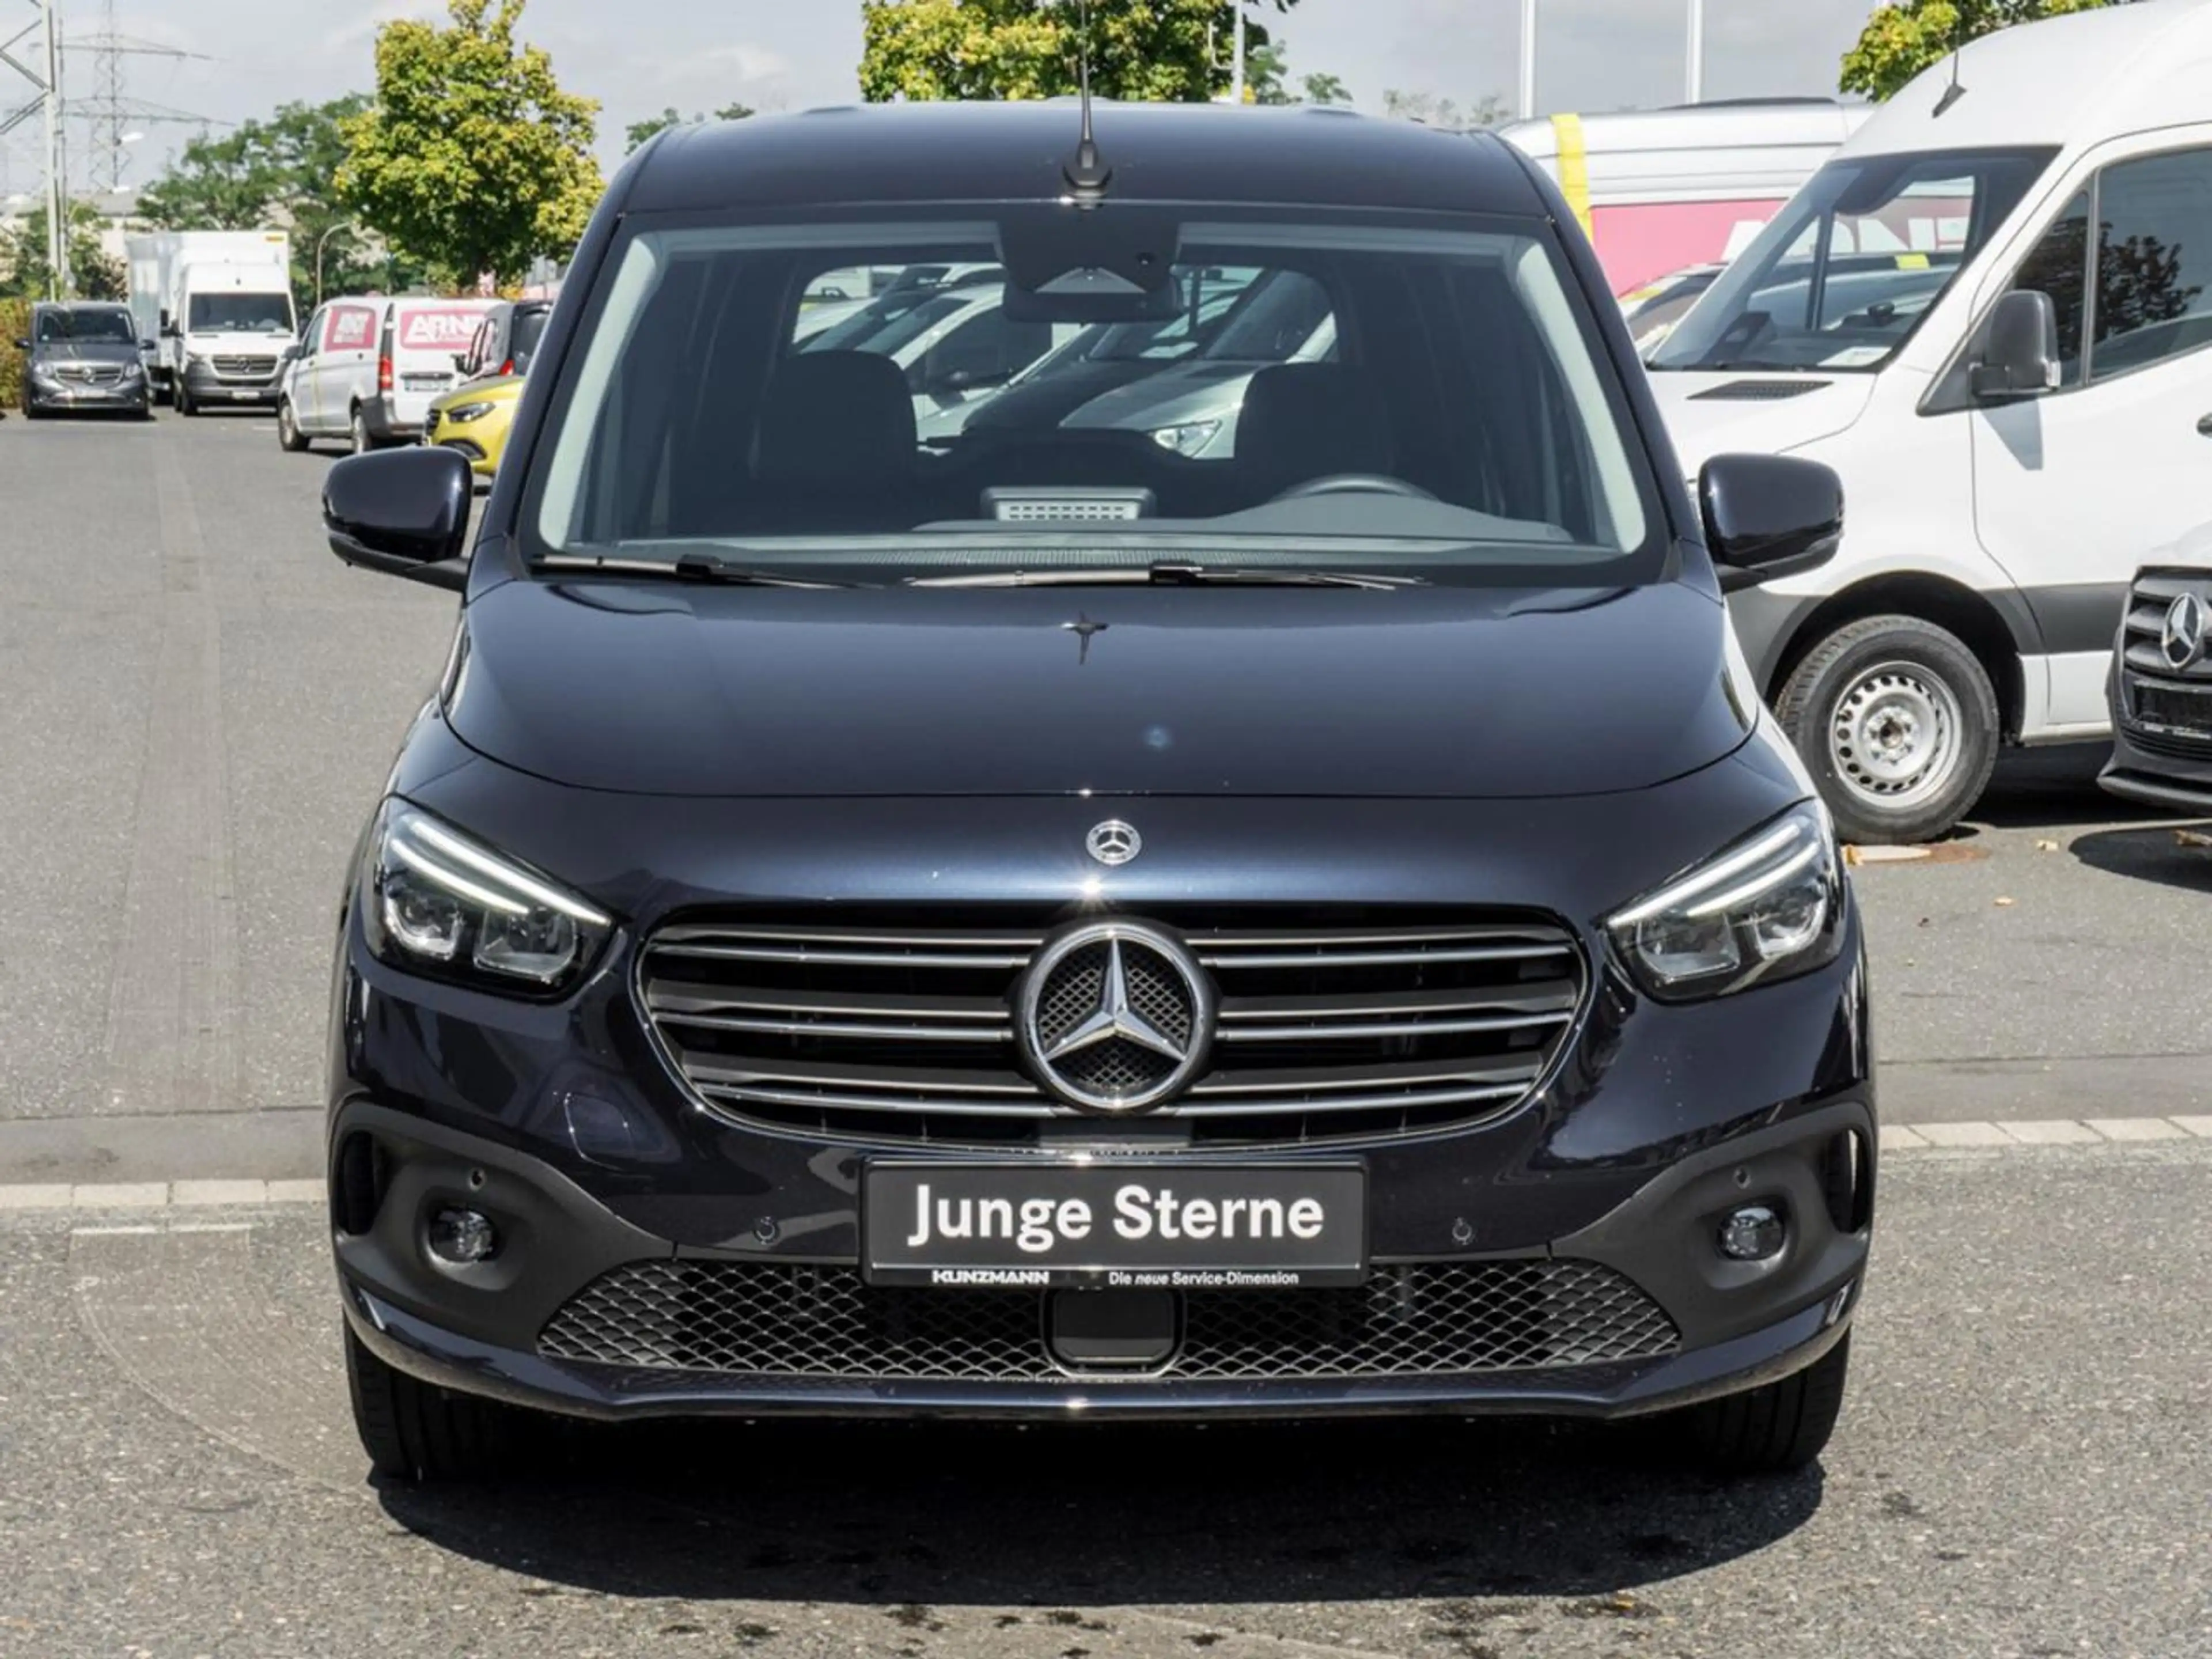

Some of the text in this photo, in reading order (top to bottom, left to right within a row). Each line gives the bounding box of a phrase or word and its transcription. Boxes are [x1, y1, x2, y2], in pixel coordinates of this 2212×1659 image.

[907, 1184, 1324, 1252] Junge Sterne
[932, 1270, 1050, 1284] KUNZMANN
[1108, 1271, 1300, 1285] Die neue Service-Dimension
